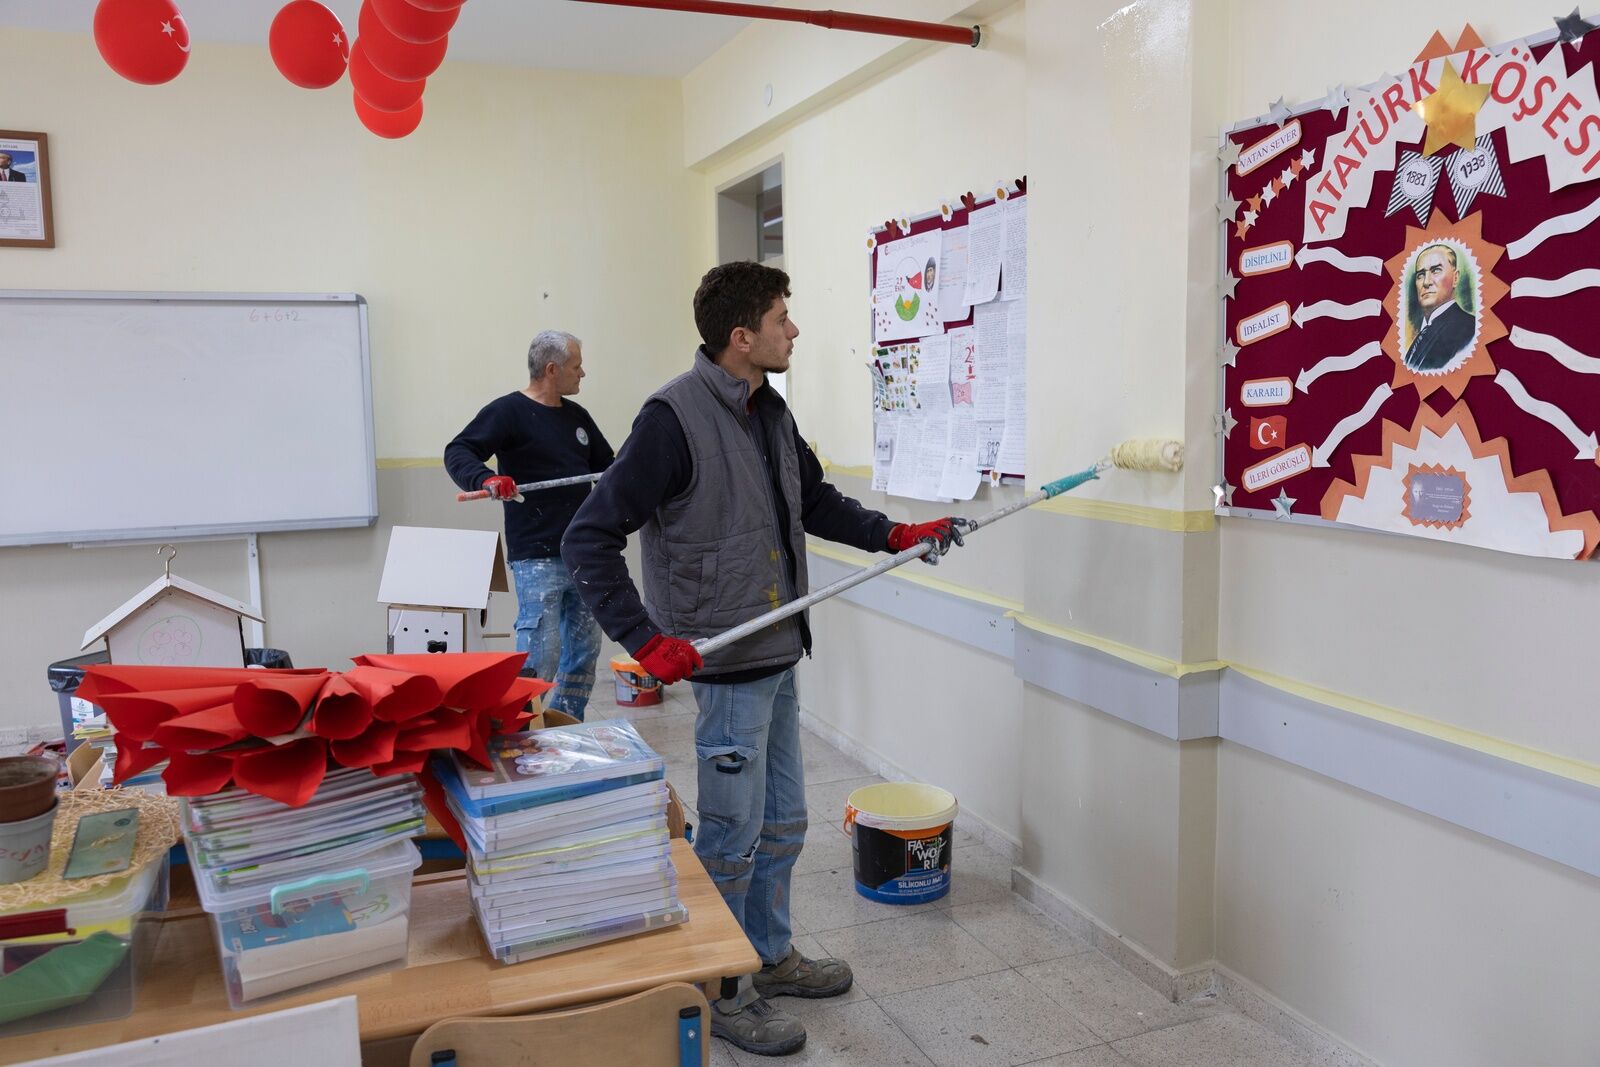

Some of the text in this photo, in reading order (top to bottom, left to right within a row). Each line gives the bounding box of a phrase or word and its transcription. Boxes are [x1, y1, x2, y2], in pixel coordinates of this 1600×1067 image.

[1240, 129, 1297, 168] VATAN SEVER
[1308, 59, 1437, 233] ATATÜRK
[1406, 154, 1485, 186] 1881 1938
[1245, 249, 1287, 268] DİSİPLİNLİ
[1244, 313, 1280, 336] İDEALİST
[1246, 388, 1283, 398] KARARLI
[1249, 451, 1307, 484] İLERİ GÖRÜŞLÜ
[898, 879, 931, 889] SİLİKONLU
